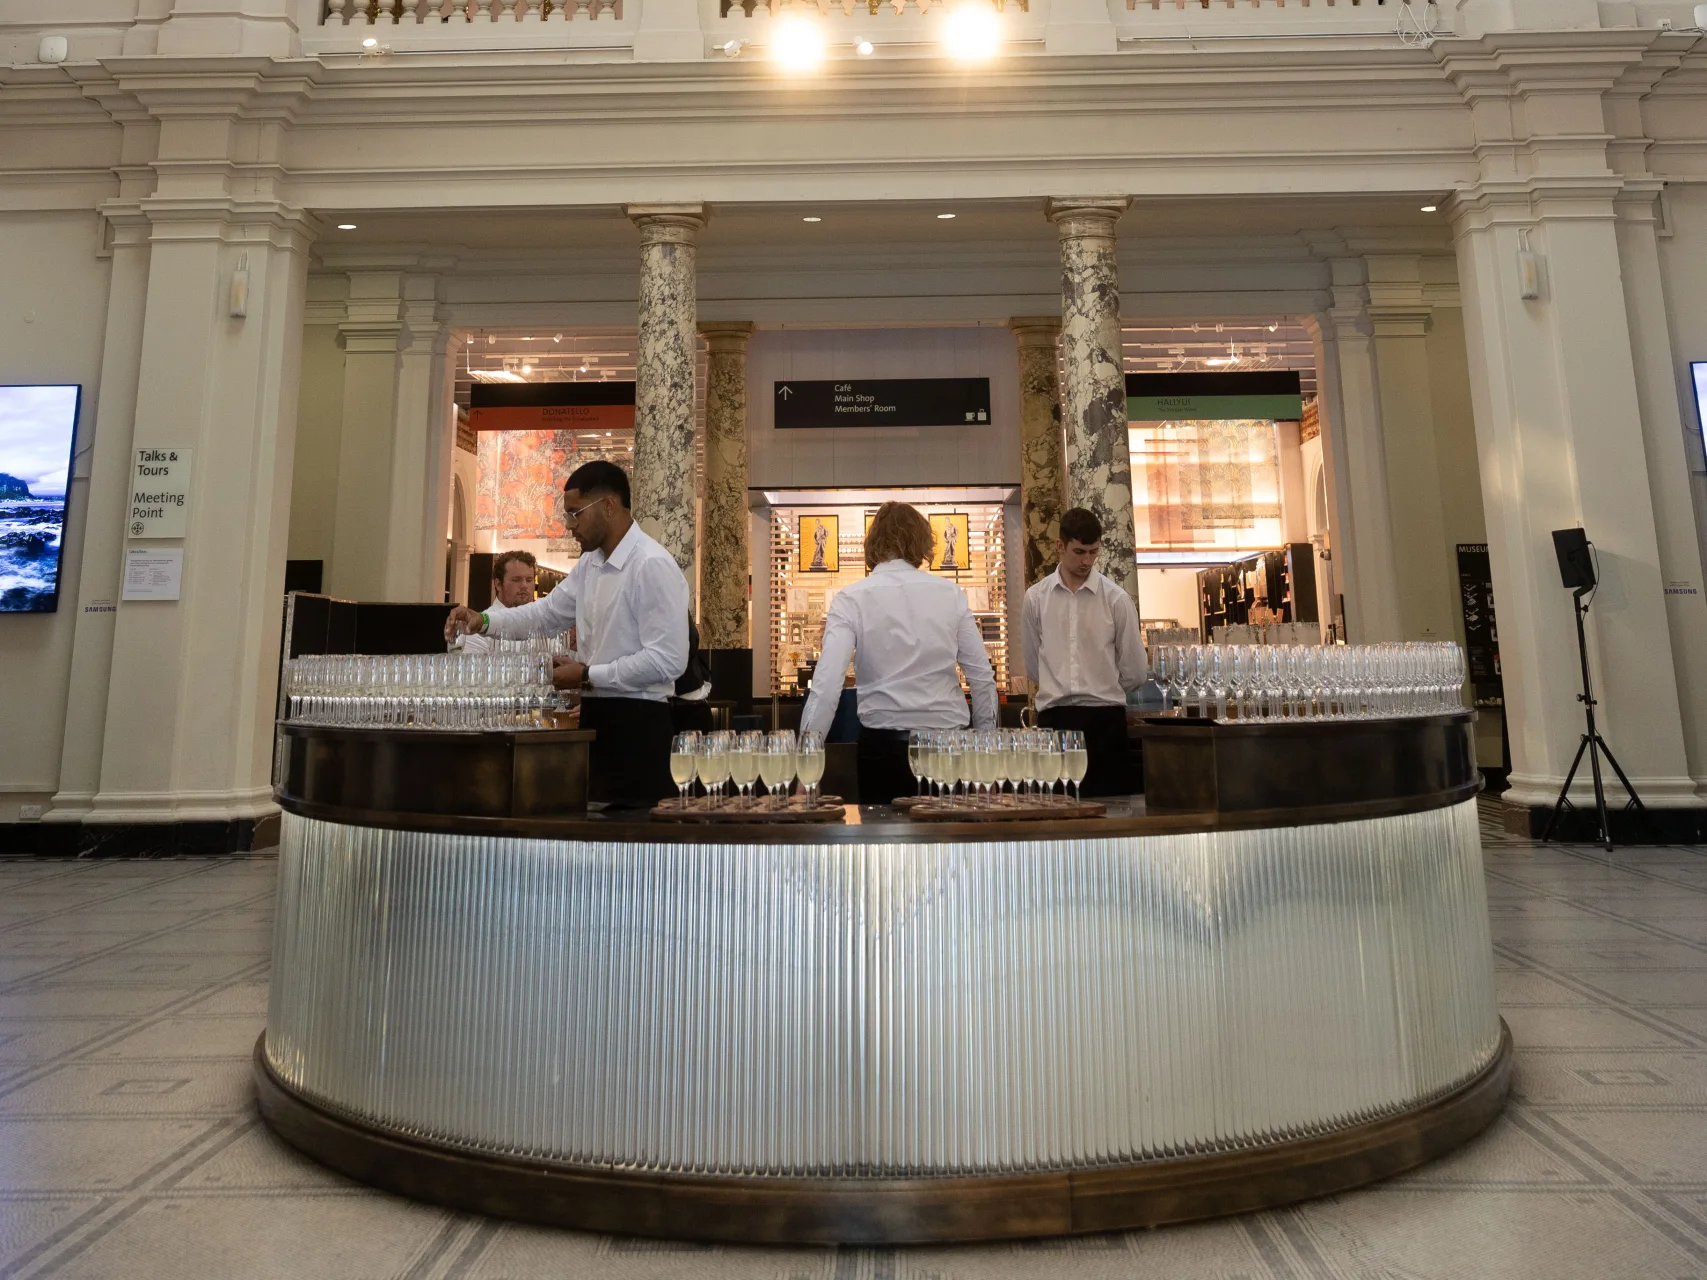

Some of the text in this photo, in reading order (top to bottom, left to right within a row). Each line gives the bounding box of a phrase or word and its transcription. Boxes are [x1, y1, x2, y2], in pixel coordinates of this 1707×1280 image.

[835, 384, 852, 392] Café
[855, 394, 875, 404] Shop
[542, 407, 590, 415] DONATELLO
[874, 404, 897, 412] Room
[139, 450, 178, 462] Talks &
[138, 464, 169, 476] Tours
[133, 492, 185, 506] Meeting
[132, 507, 164, 518] Point
